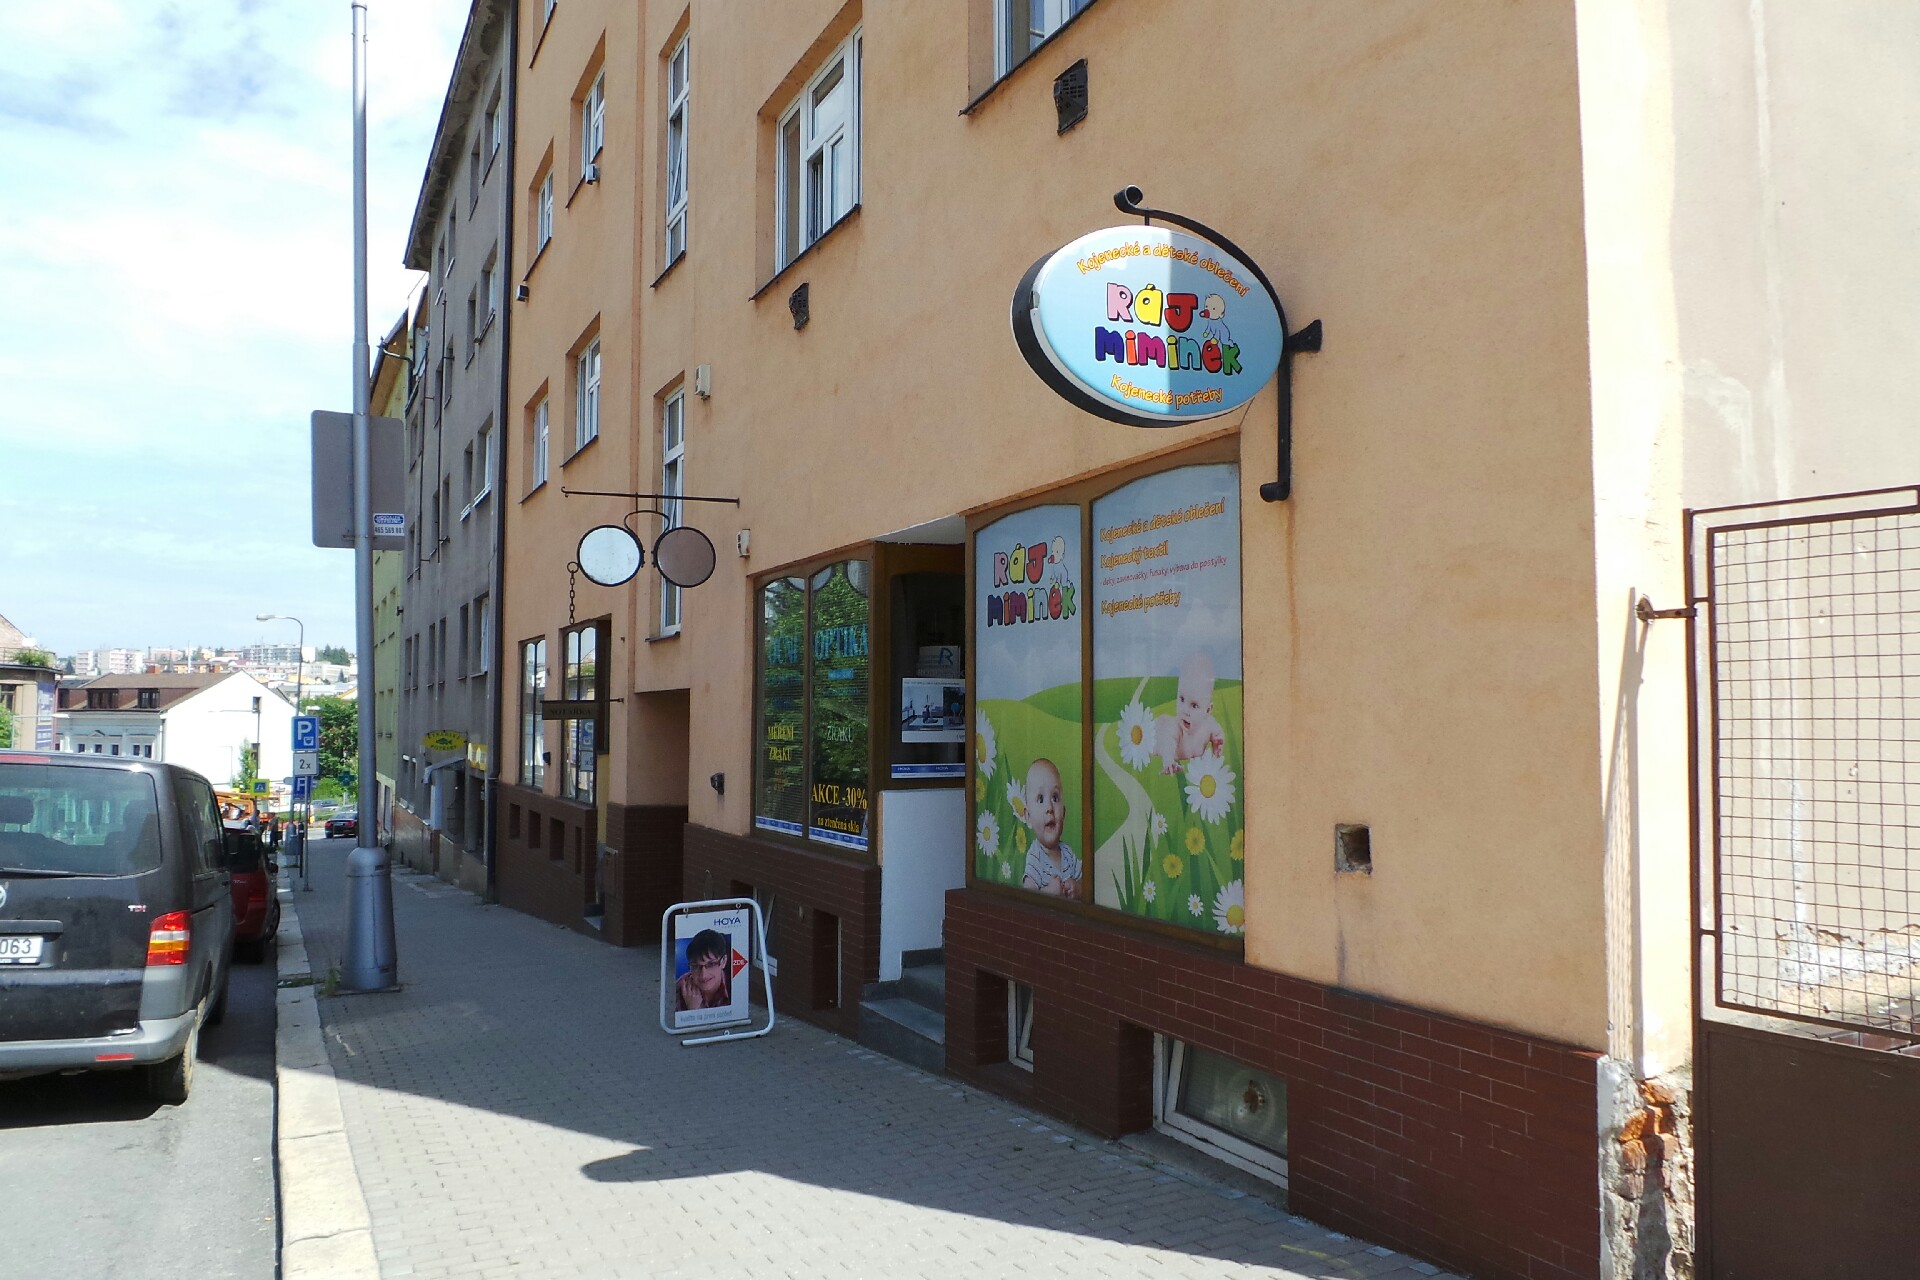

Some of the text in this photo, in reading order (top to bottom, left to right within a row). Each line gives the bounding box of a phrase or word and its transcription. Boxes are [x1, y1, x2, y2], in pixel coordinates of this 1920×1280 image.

[1077, 241, 1251, 298] Kojenecké a dětské oblečení
[1110, 374, 1223, 410] Kojenecké potřeby
[1100, 517, 1142, 544] Kojenecké
[1150, 508, 1183, 532] dětské
[1184, 496, 1226, 523] oblečení
[1100, 540, 1169, 571] Kojenecký textil
[1101, 588, 1182, 618] Kojenecké potřeby
[815, 624, 869, 660] OPTIKA
[298, 721, 312, 741] P
[827, 725, 854, 742] ZRAKU
[299, 759, 311, 769] 2x
[811, 783, 840, 805] AKCE
[842, 787, 868, 810] -30%
[713, 916, 741, 926] HOYA
